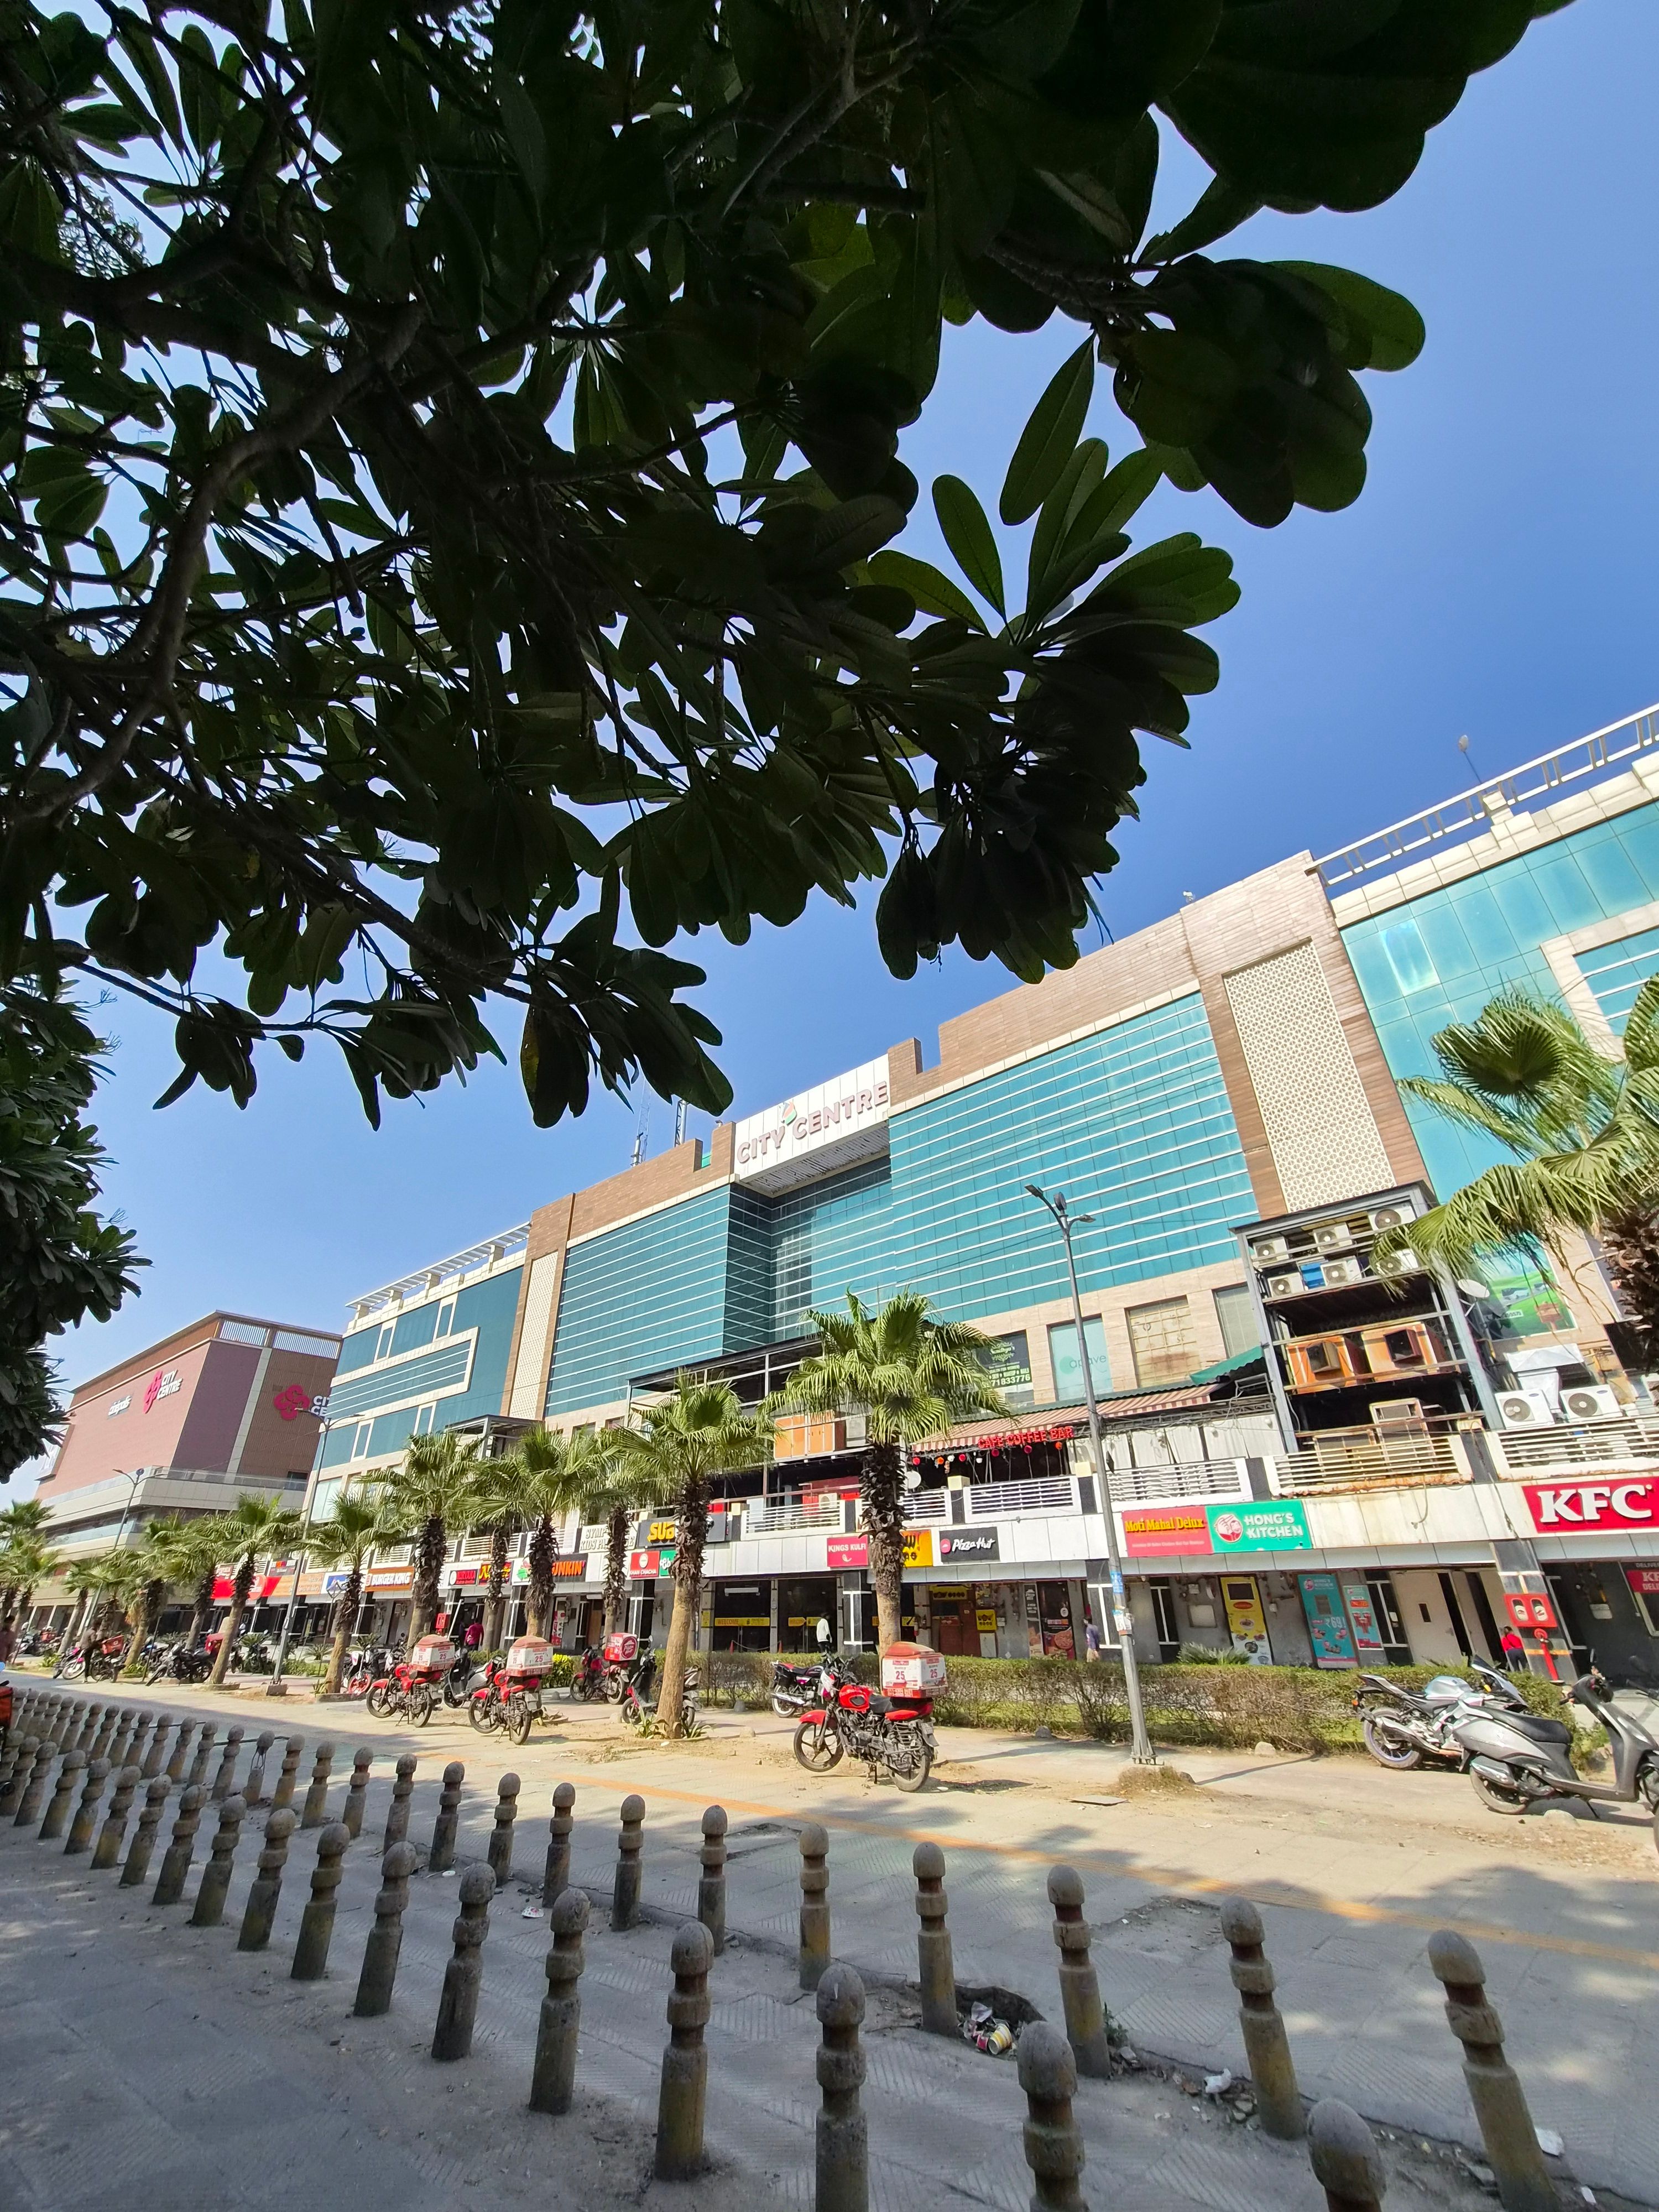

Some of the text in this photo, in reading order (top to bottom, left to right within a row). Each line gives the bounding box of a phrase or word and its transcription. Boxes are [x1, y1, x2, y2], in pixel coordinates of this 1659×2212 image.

[737, 1081, 889, 1164] CITY CENTRE
[161, 1369, 178, 1386] CITY
[990, 1374, 1031, 1387] 71833776
[156, 1378, 183, 1400] CENTRE
[978, 1426, 1074, 1449] CAFE COFFEE BAR
[1537, 1485, 1652, 1522] KFC
[1125, 1520, 1145, 1533] Moti
[1147, 1517, 1175, 1531] Mahal
[1177, 1516, 1205, 1528] Delux
[1244, 1512, 1293, 1526] HONG'S
[1246, 1525, 1303, 1539] KITCHEN
[580, 1540, 596, 1551] KIDS
[828, 1542, 867, 1553] KINGS KULFI
[952, 1537, 995, 1552] Pizza Hut
[372, 1572, 413, 1586] BURGER KING
[895, 1670, 905, 1680] 25
[930, 1668, 938, 1678] 25
